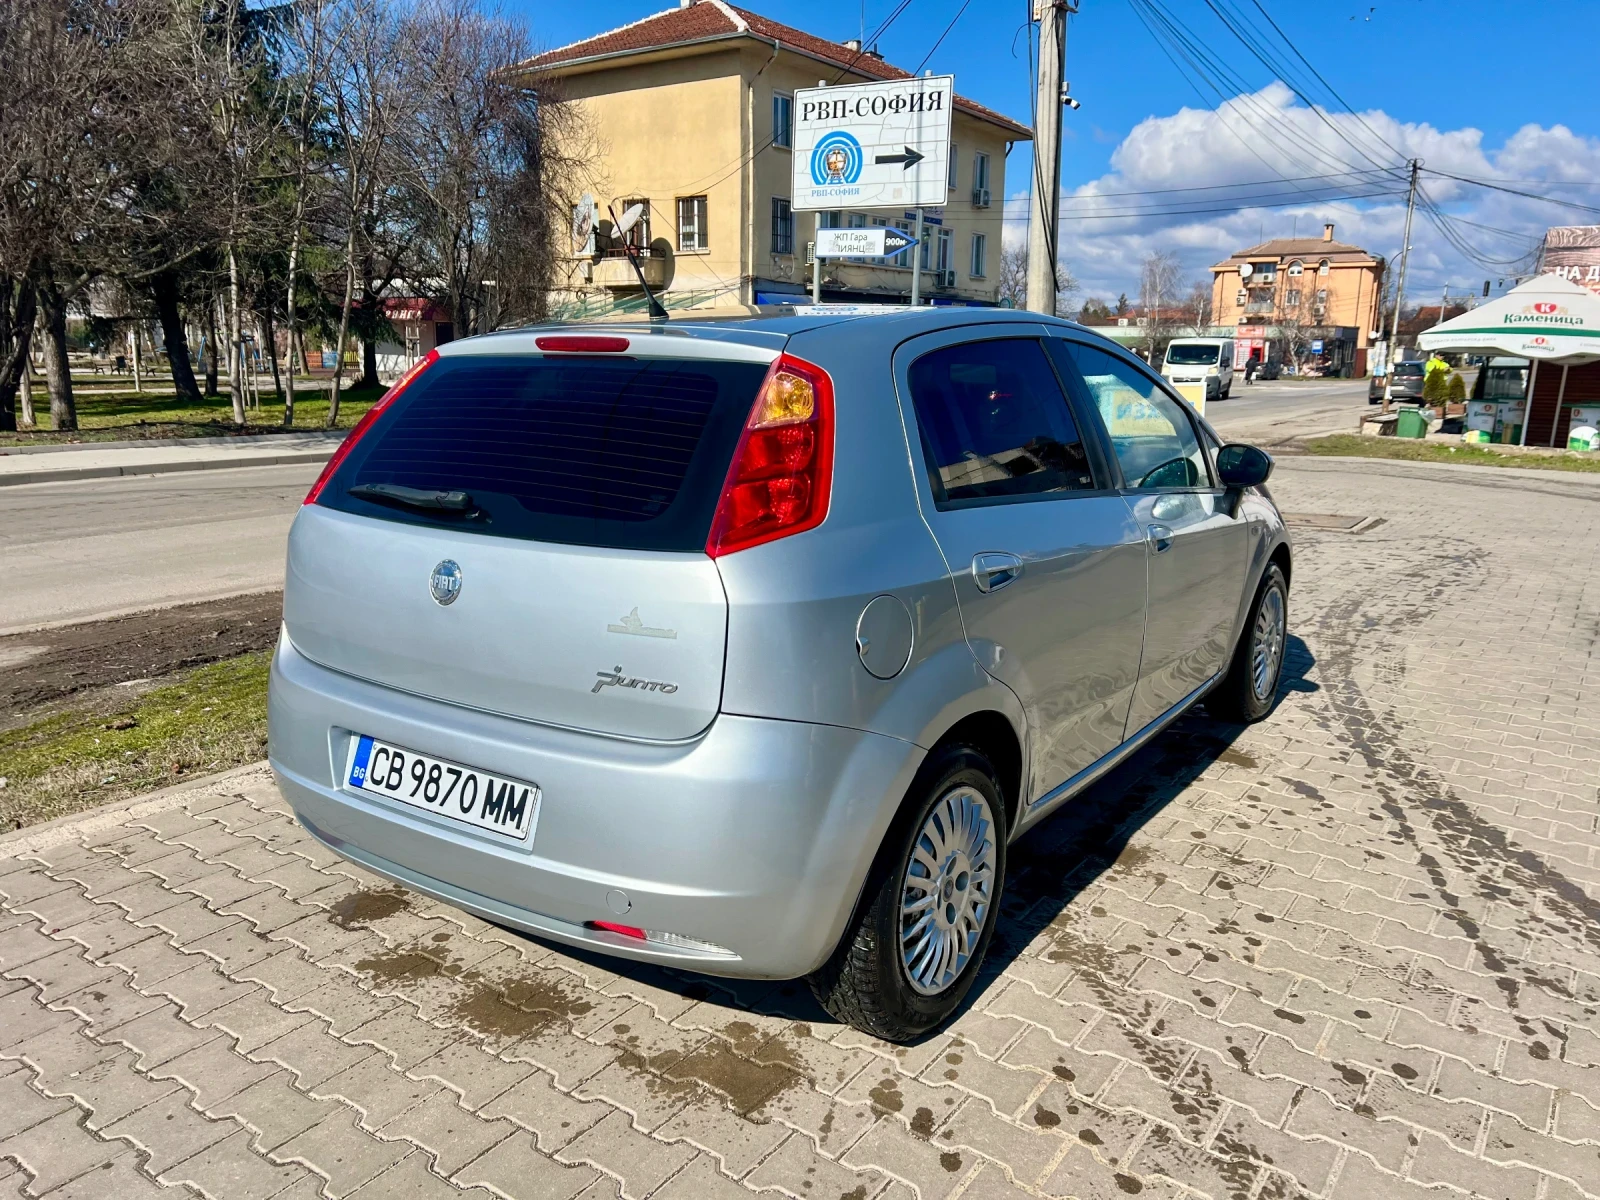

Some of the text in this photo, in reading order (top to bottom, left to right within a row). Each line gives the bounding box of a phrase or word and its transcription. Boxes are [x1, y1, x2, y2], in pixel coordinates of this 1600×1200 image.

[801, 90, 944, 122] РВП-СОФИЯ
[811, 187, 860, 197] РВП-СОФИЯ
[834, 233, 868, 243] ЖП Гара
[1555, 265, 1581, 281] НА
[1503, 313, 1584, 326] Каменица
[433, 574, 455, 591] FIAT
[353, 765, 366, 780] BG
[370, 747, 530, 831] CB 9870 MM
